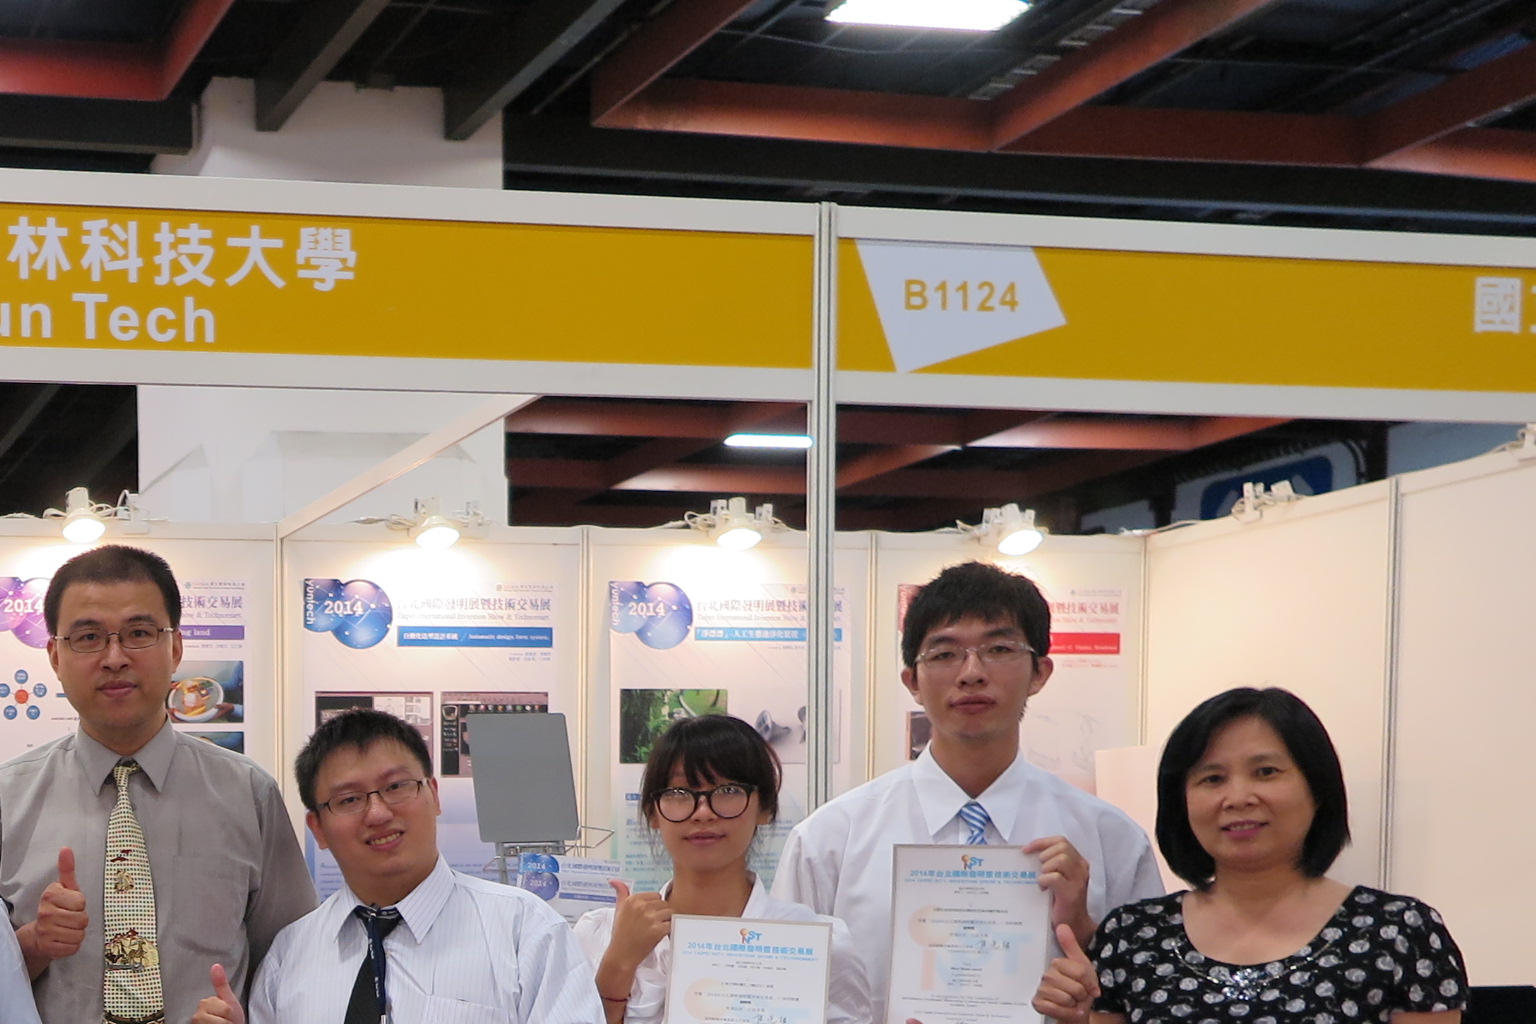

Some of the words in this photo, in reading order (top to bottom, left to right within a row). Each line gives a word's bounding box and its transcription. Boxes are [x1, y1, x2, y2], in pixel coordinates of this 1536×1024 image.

[904, 279, 1019, 312] B1124
[1474, 276, 1536, 333] 國
[72, 292, 216, 343] Tech
[3, 599, 45, 613] 2014
[305, 579, 315, 625] yuntech
[324, 601, 364, 615] 2014
[628, 602, 666, 616] 2014
[527, 862, 546, 870] 2014
